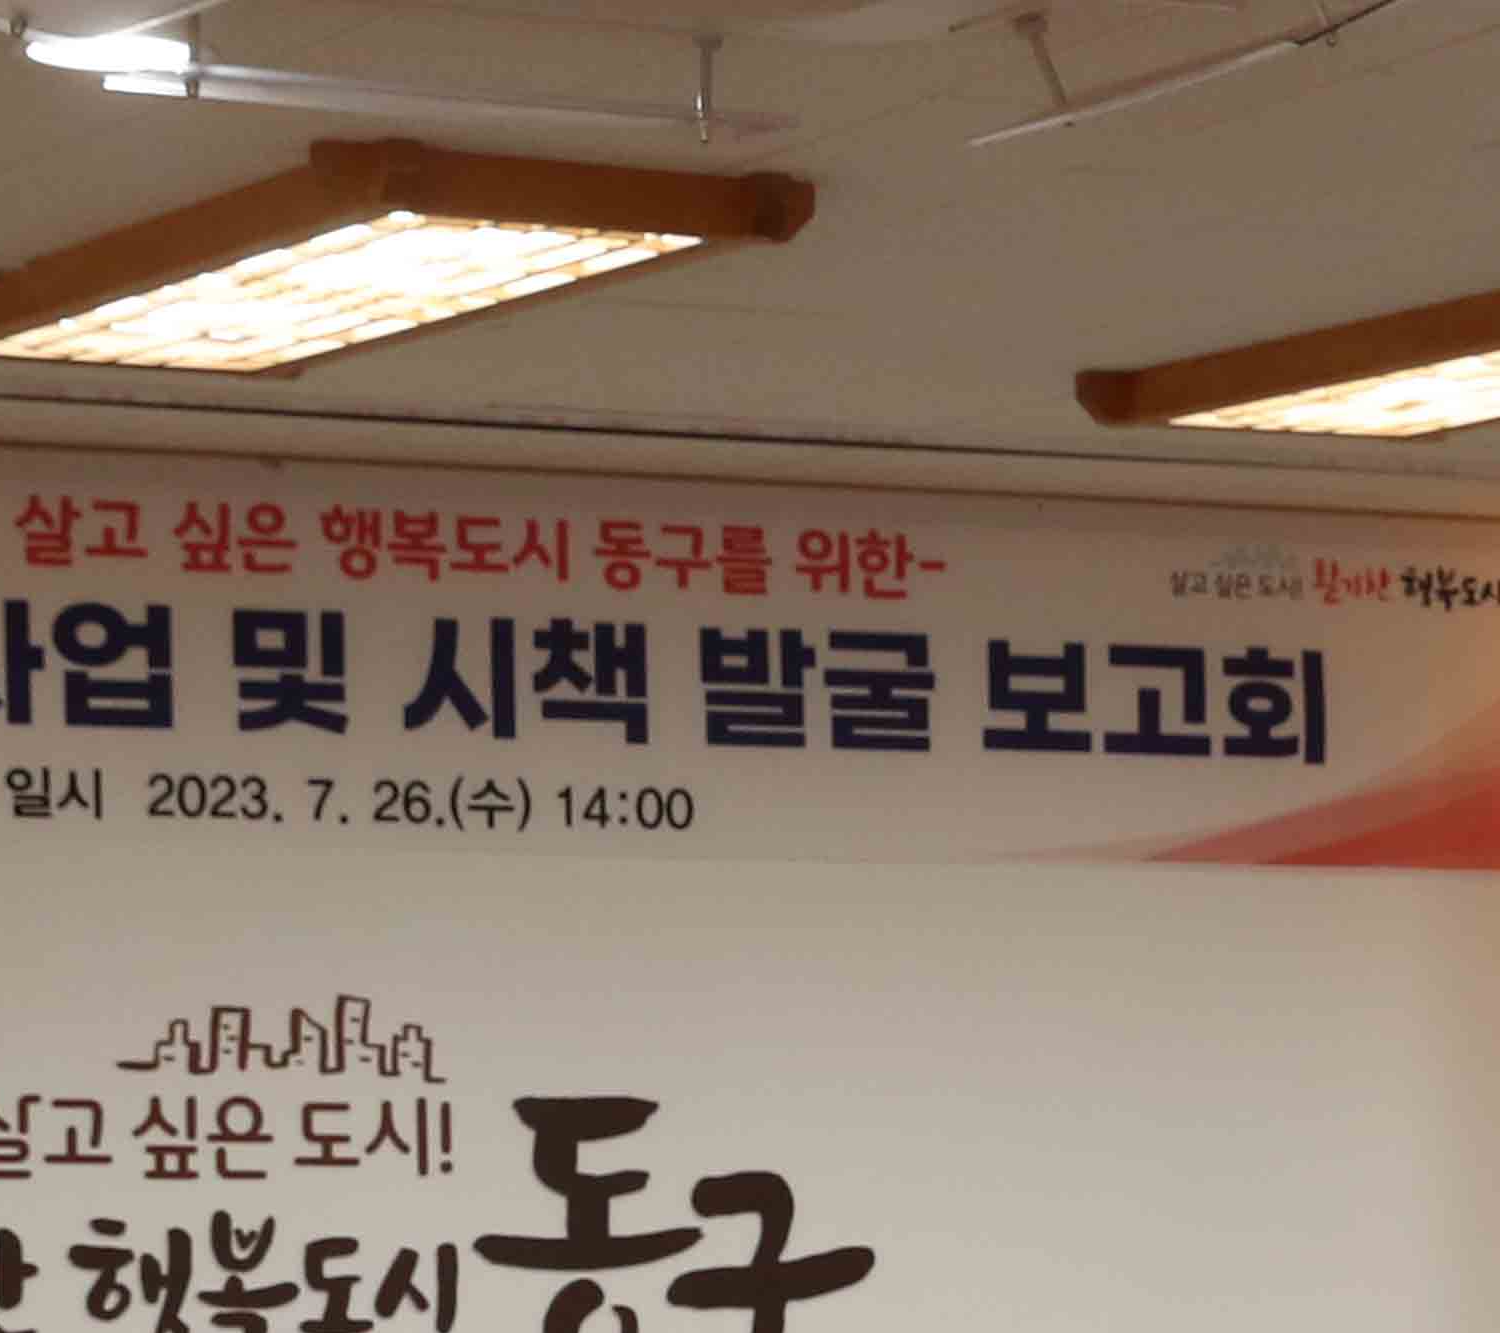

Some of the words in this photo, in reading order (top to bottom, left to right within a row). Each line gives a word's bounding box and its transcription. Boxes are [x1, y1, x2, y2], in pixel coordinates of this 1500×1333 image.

[15, 494, 148, 567] 살고
[173, 501, 298, 574] 싶은
[320, 504, 570, 582] 행복도시
[594, 519, 773, 596] 동구를
[795, 527, 946, 600] 위한-
[232, 607, 349, 734] 및
[403, 617, 649, 745] 시책
[699, 626, 936, 752] 발굴
[982, 639, 1326, 765] 보고회
[147, 772, 283, 823] 2023.
[307, 778, 349, 825] 7.
[373, 776, 532, 831] 26.(수)
[557, 786, 695, 831] 14:00
[131, 1095, 274, 1180] 싶은
[293, 1096, 453, 1177] 도시!
